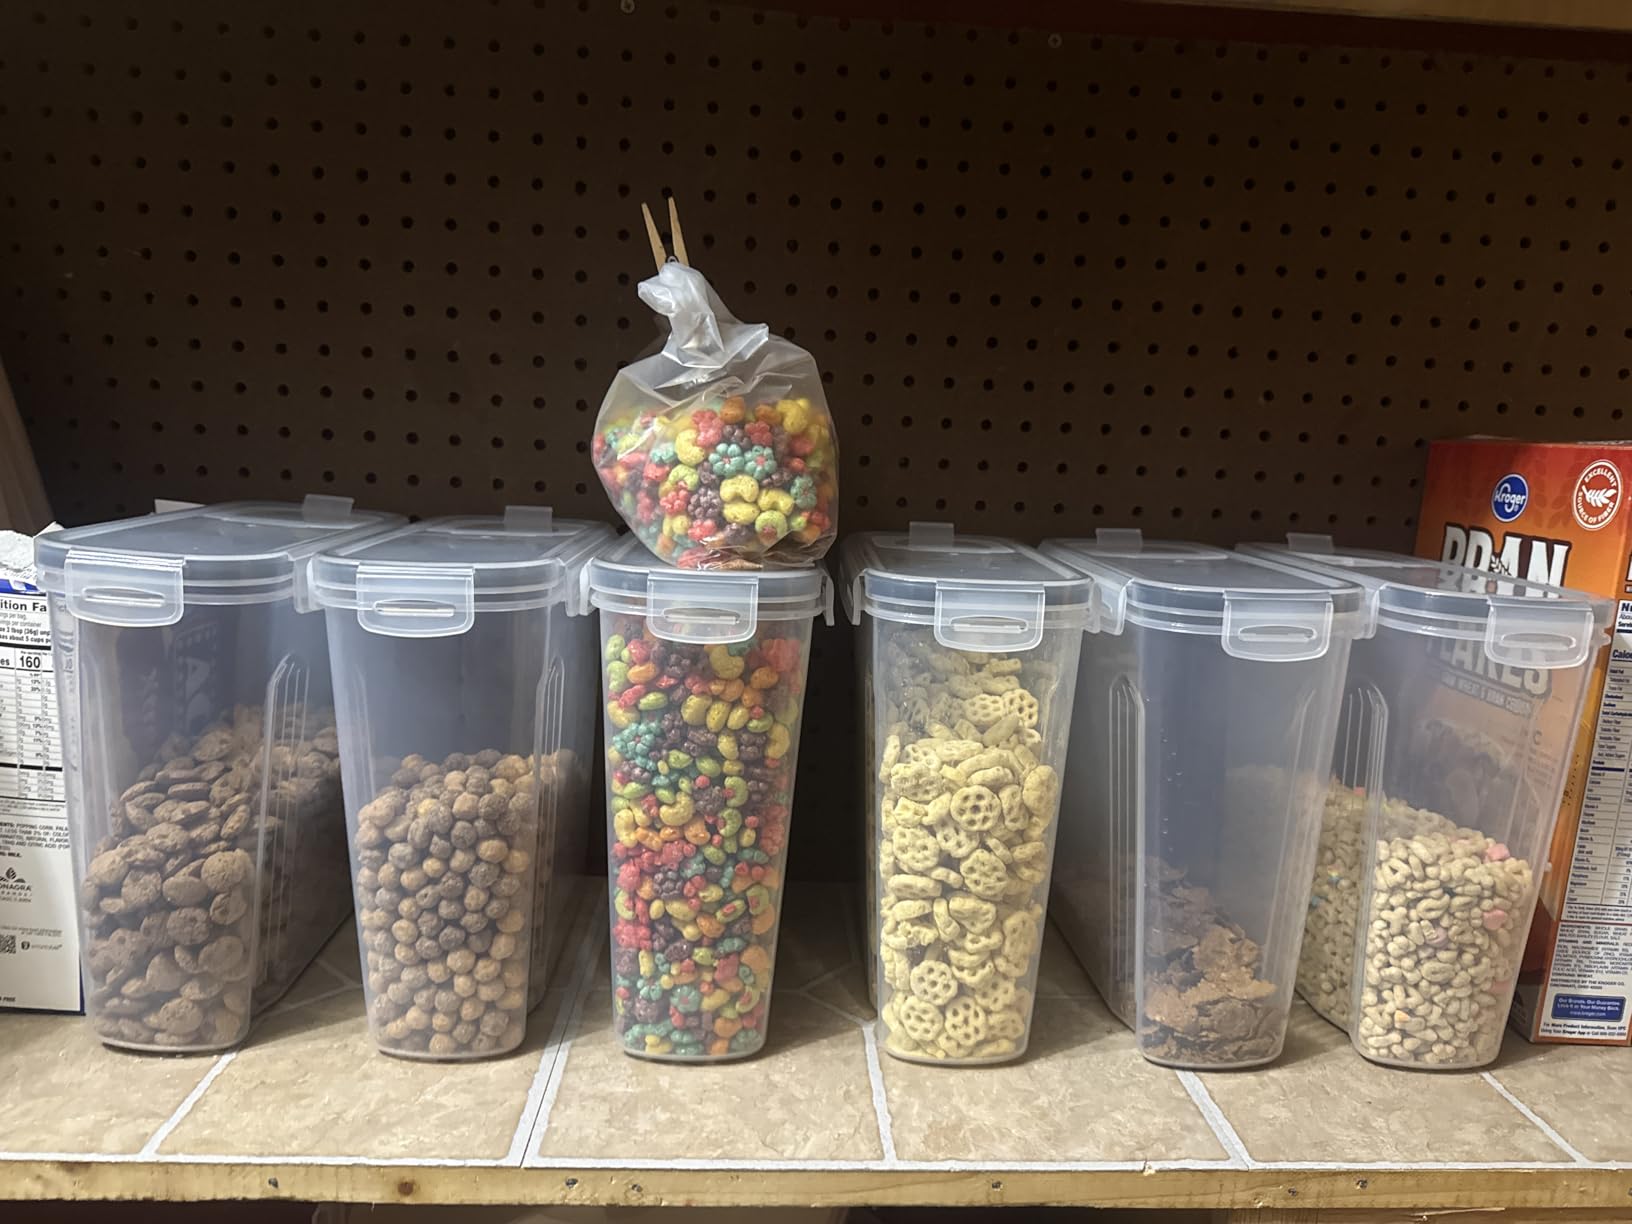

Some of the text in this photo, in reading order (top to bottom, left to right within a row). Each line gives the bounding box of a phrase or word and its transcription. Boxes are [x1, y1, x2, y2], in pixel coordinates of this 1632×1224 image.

[1584, 468, 1617, 487] EXCELLENT
[1494, 482, 1526, 513] Kroger
[1577, 491, 1588, 521] SOURCE
[1598, 502, 1615, 522] FIBER
[1440, 524, 1570, 597] BRAN
[20, 656, 40, 668] 160
